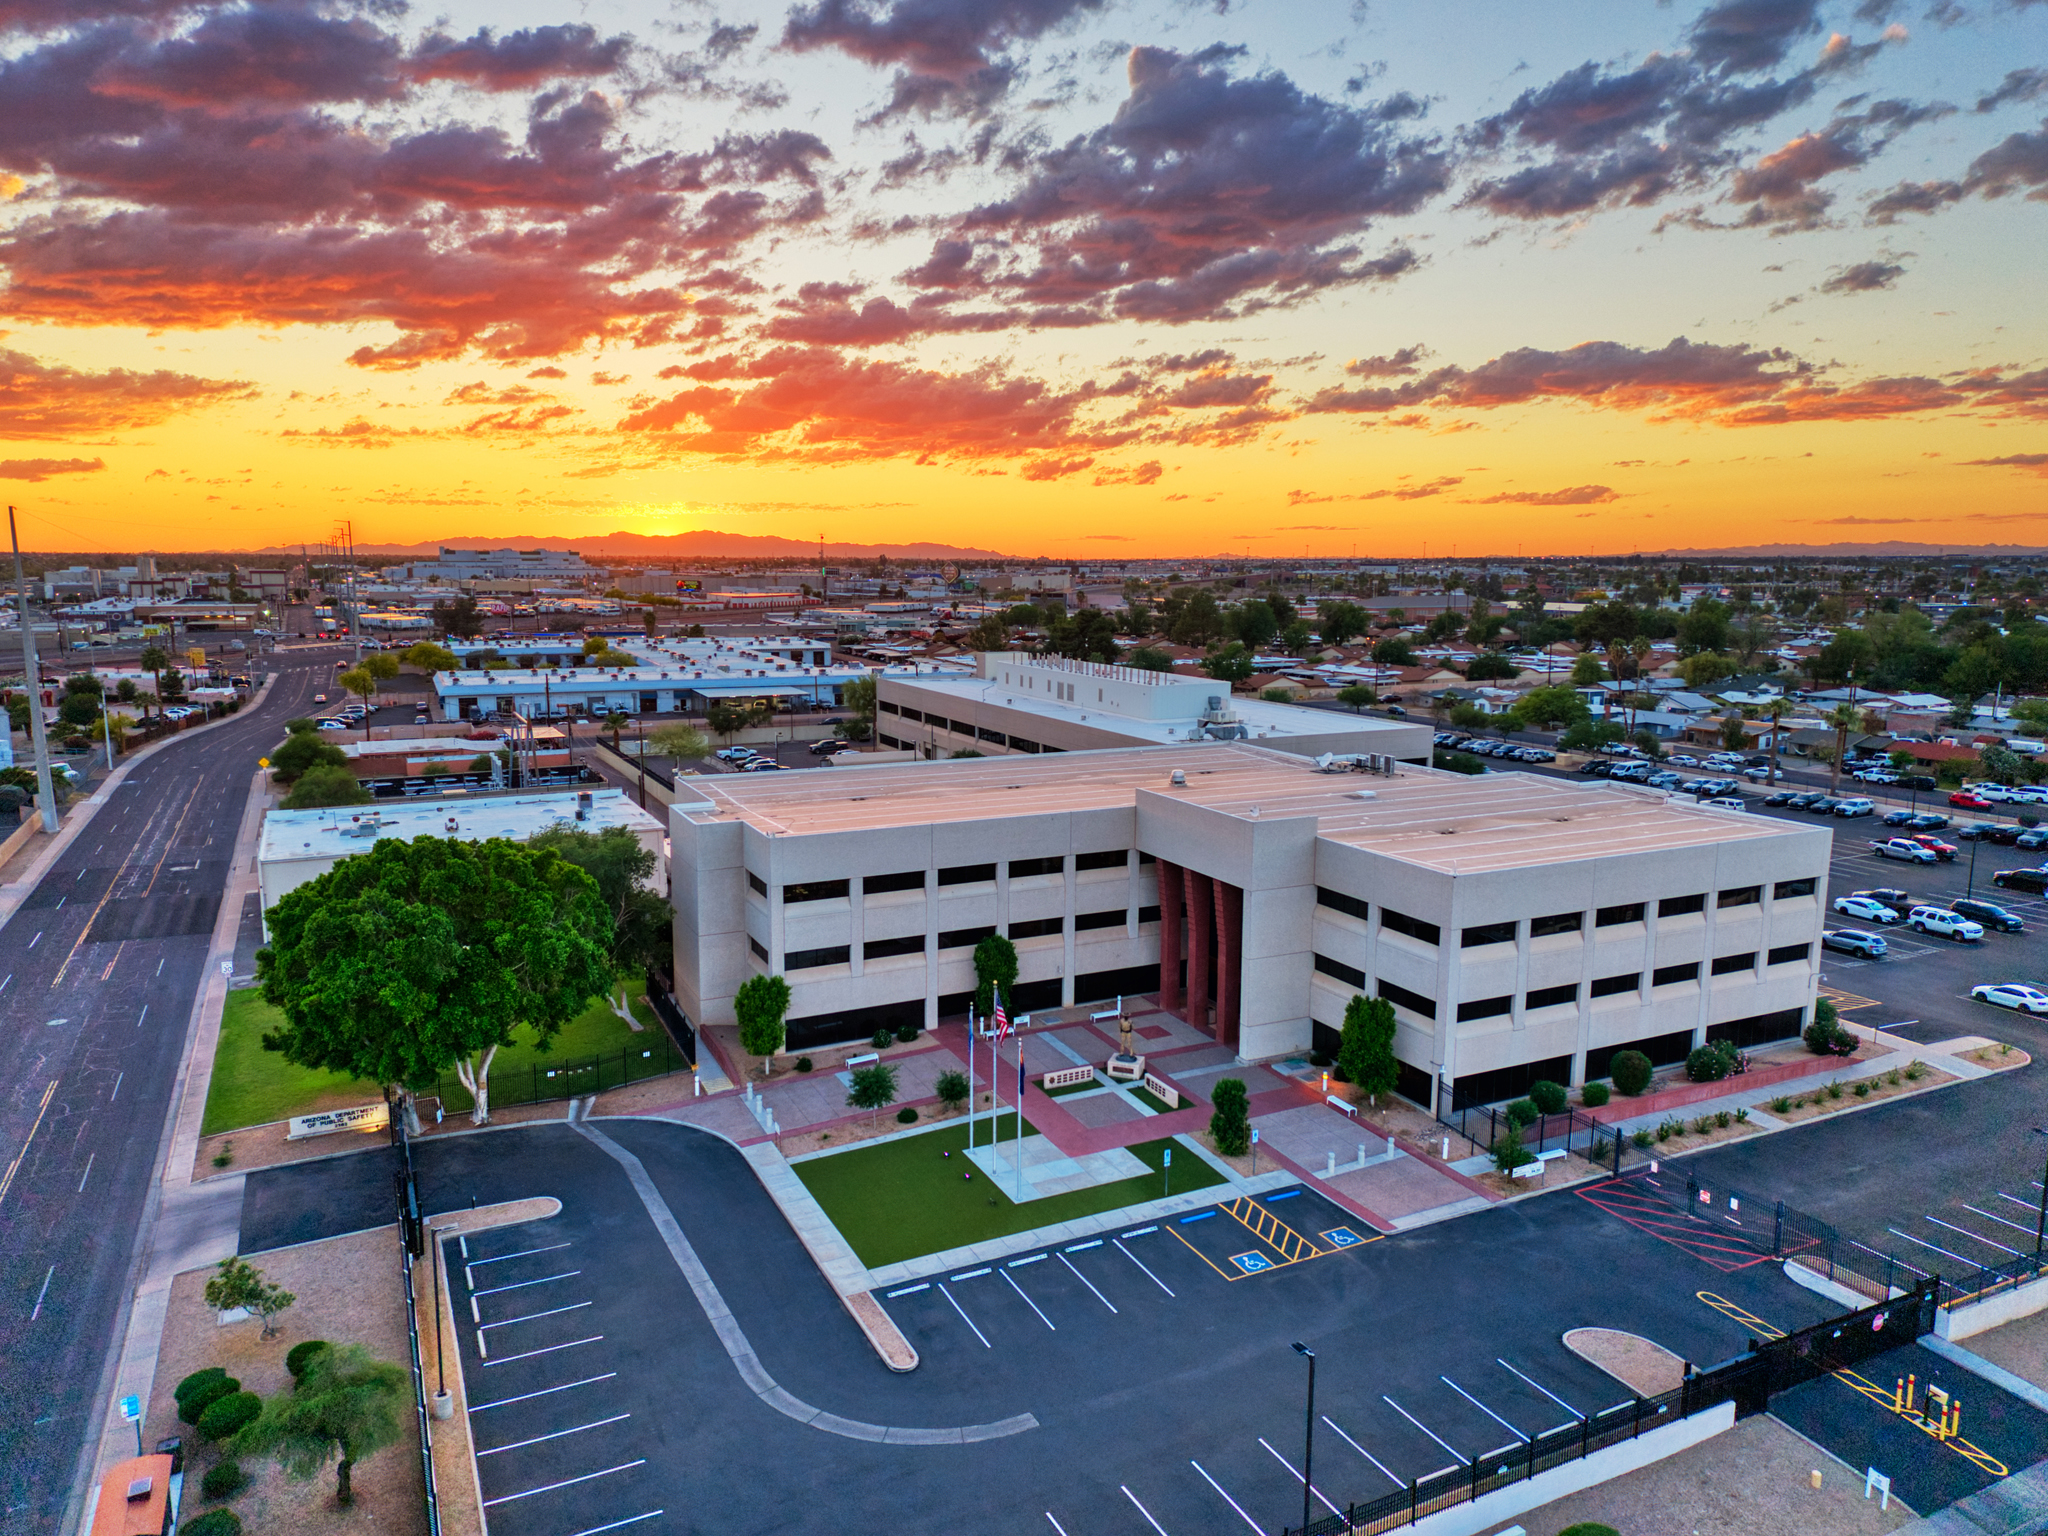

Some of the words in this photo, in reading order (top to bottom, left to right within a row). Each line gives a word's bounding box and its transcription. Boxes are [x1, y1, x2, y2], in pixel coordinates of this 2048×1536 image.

[301, 1115, 331, 1124] ARIZONA
[335, 1106, 378, 1119] DEPARTMENT
[320, 1118, 344, 1126] PUBLIC
[348, 1112, 374, 1121] SAFETY
